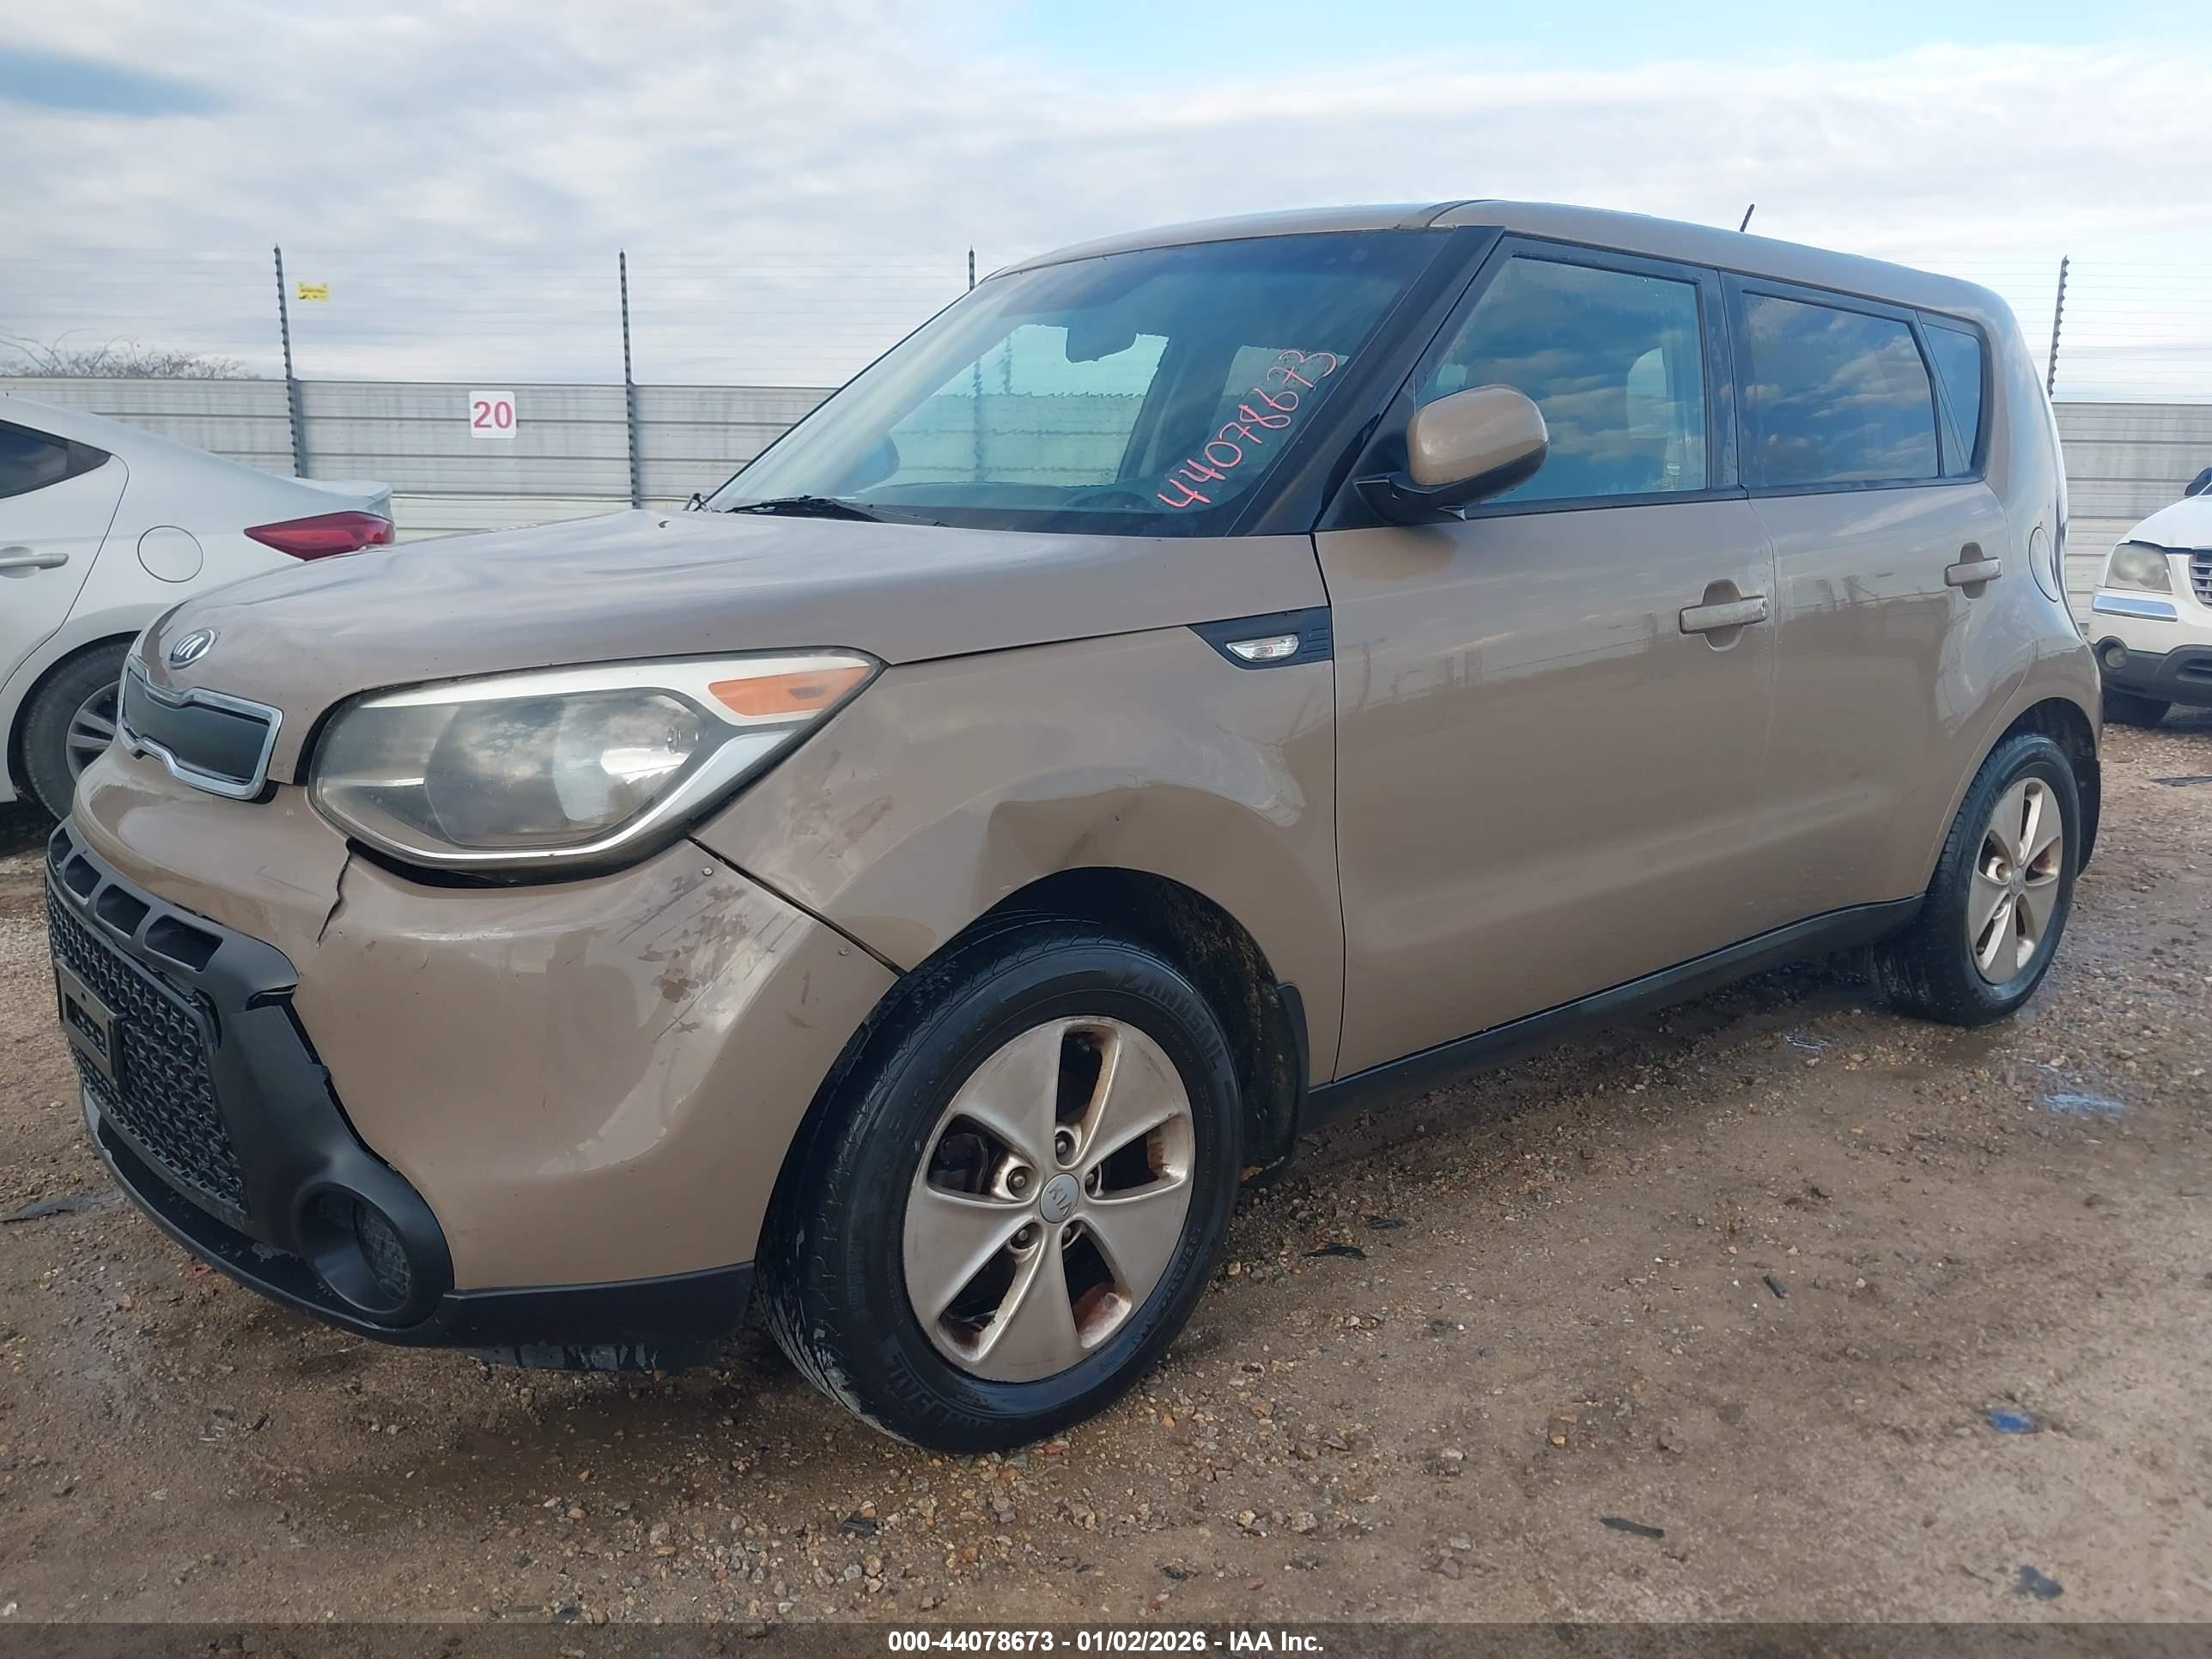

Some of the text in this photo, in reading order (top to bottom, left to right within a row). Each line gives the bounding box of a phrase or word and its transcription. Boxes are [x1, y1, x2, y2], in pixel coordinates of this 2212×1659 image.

[473, 400, 513, 429] 20
[1156, 348, 1339, 508] 44078673
[1047, 1181, 1073, 1218] KIA
